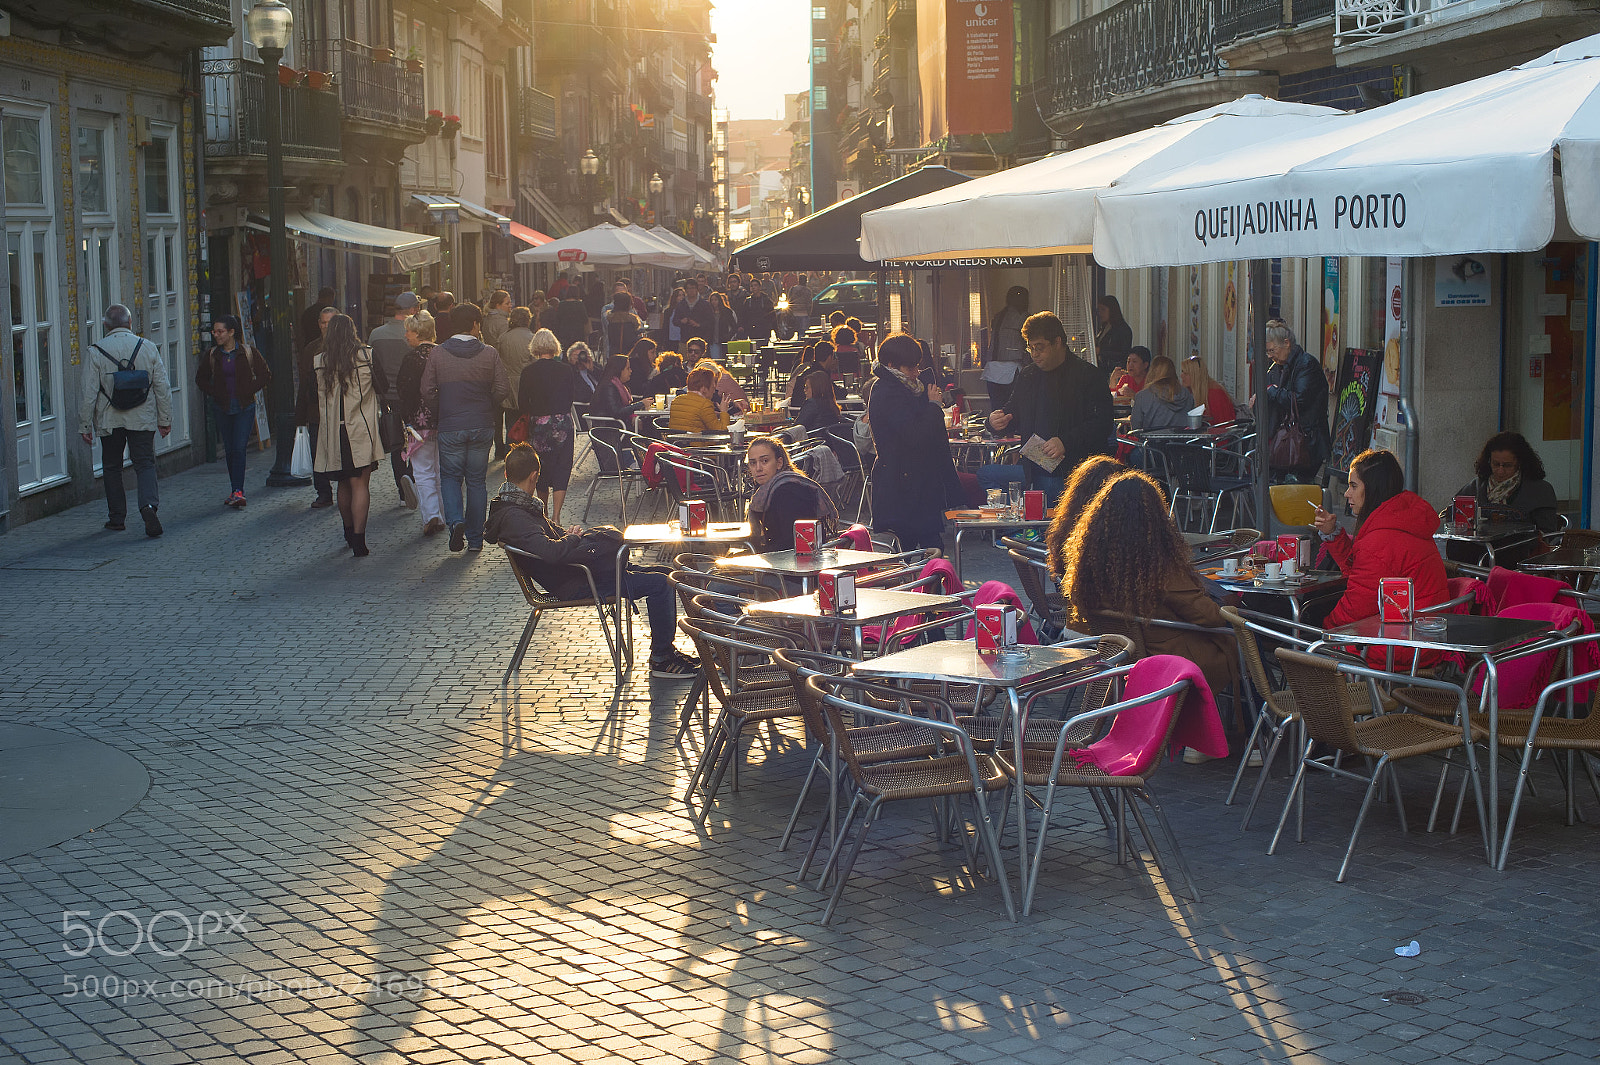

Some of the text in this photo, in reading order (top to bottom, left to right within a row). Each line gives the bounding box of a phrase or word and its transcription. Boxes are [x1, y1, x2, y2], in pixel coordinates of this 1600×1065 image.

[965, 17, 999, 27] unicer
[1194, 192, 1407, 248] QUEIJADINHA PORTO
[904, 258, 946, 267] WORLD
[949, 257, 987, 267] NEEDS
